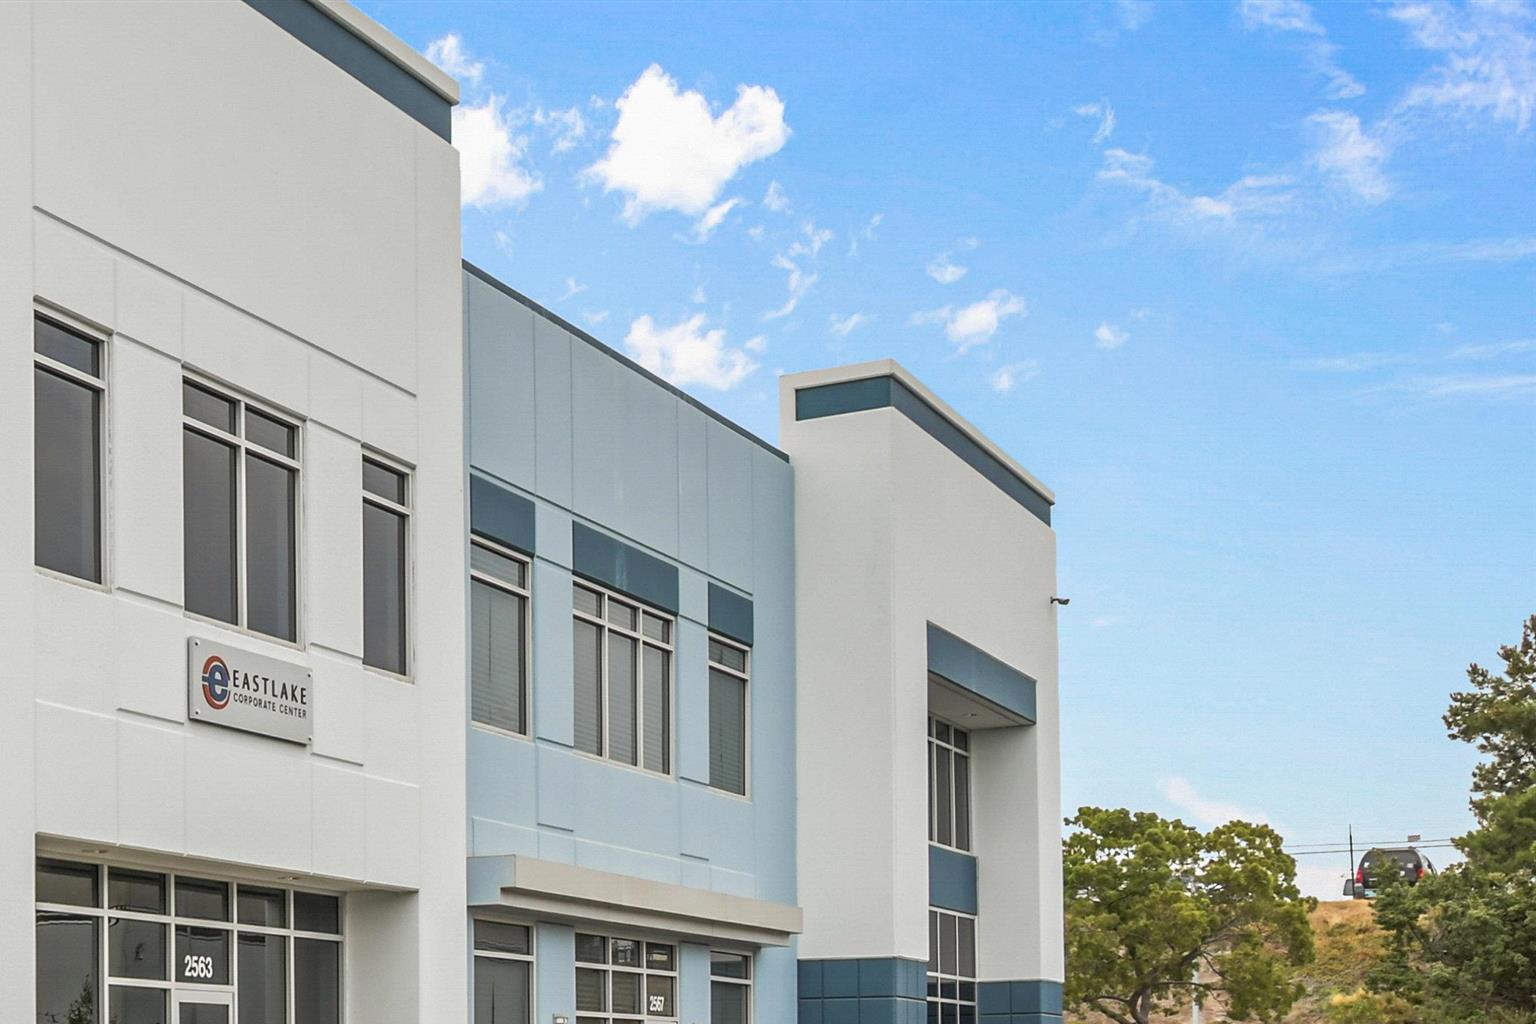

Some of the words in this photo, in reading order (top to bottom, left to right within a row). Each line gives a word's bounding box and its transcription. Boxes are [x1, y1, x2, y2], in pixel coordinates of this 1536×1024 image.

[232, 670, 307, 705] EASTLAKE
[233, 692, 277, 712] CORPORATE
[279, 704, 307, 719] CENTER
[184, 954, 213, 978] 2563
[649, 995, 665, 1012] 2567
